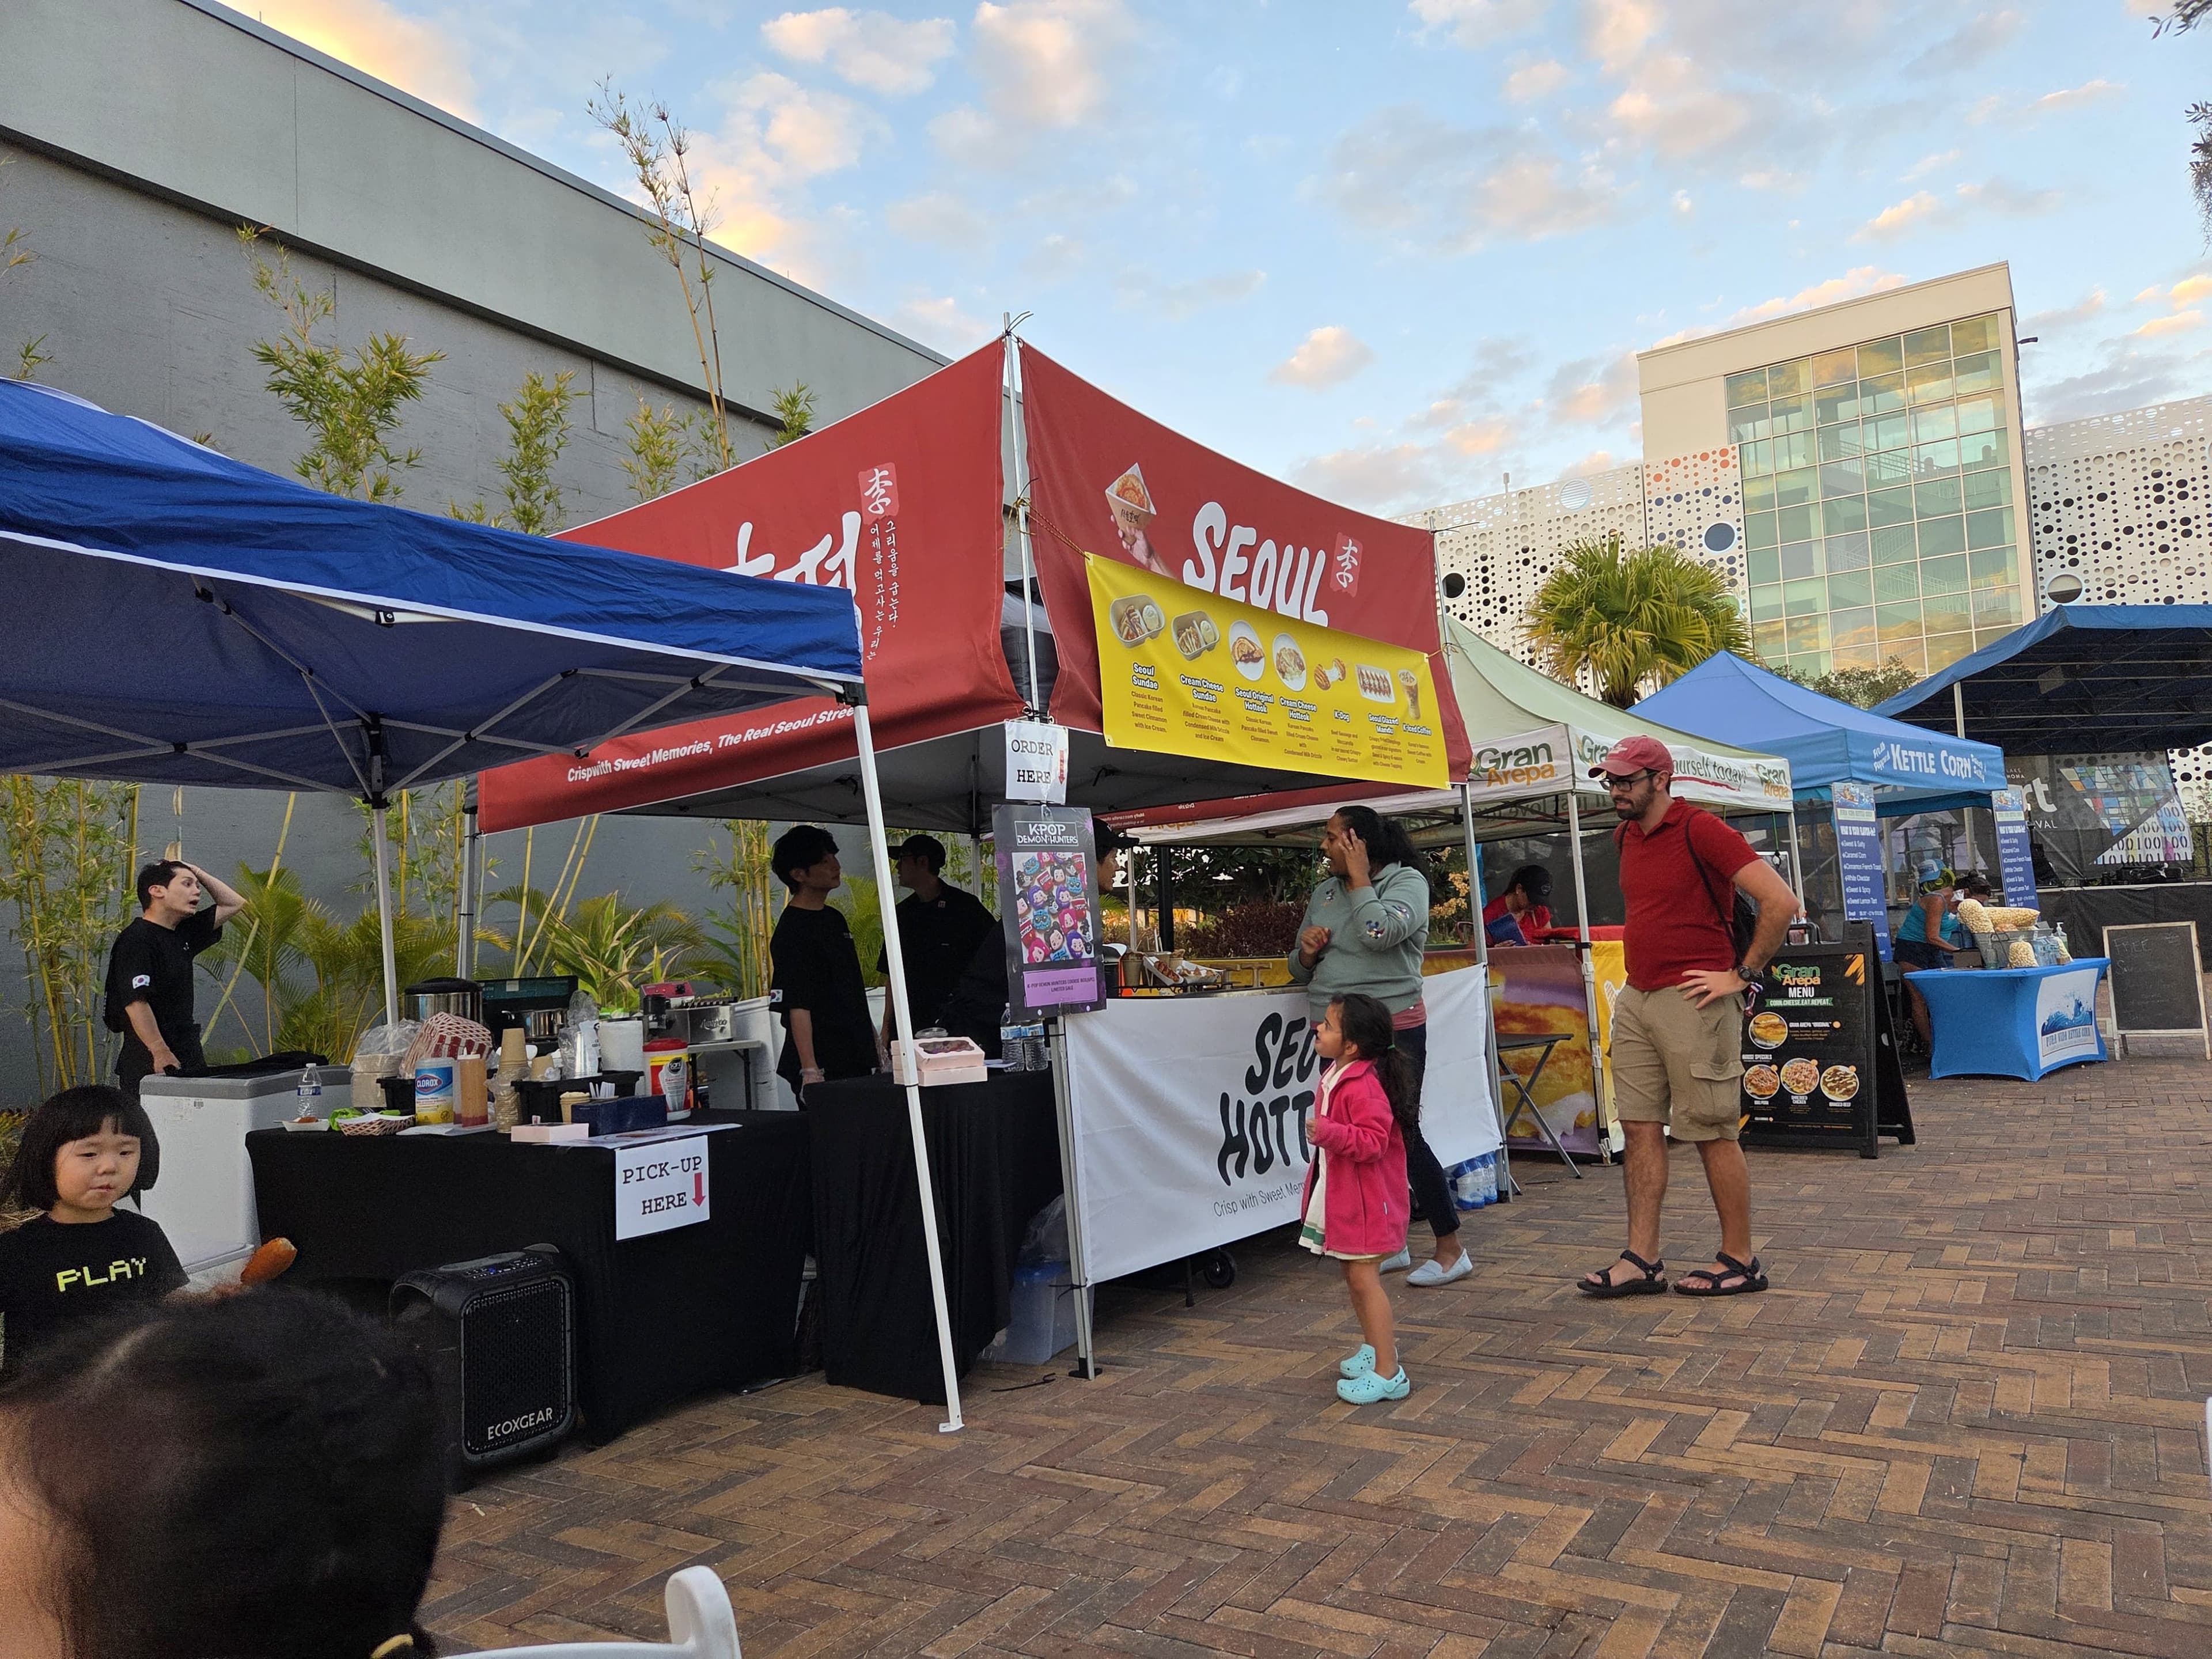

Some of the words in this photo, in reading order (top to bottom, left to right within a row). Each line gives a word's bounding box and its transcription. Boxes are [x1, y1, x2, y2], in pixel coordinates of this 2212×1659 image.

[870, 524, 883, 565] 어제를
[885, 520, 899, 577] 그리움을
[1183, 502, 1328, 627] SEOUL
[866, 626, 884, 660] 우리는
[1133, 662, 1154, 676] Seoul
[1132, 676, 1158, 690] Sundae
[1180, 674, 1202, 687] Cream
[1202, 678, 1224, 692] Cheese
[1131, 691, 1147, 699] Classic
[1148, 695, 1163, 703] Korean
[1192, 689, 1217, 703] Sundae
[1235, 687, 1252, 699] Seoul
[1252, 689, 1274, 703] Original
[1134, 702, 1152, 710] Pancake
[1244, 700, 1268, 714] Hotteok
[1279, 696, 1297, 709] Cream
[1297, 700, 1317, 712] Cheese
[1132, 711, 1145, 719] Sweet
[1146, 714, 1167, 723] Cinnamon
[1183, 710, 1195, 718] filled
[1289, 710, 1310, 722] Hotteok
[1334, 709, 1350, 722] K-Dog
[1368, 713, 1382, 724] Seoul
[1185, 721, 1209, 730] Condensed
[1417, 726, 1432, 736] Coffee
[613, 753, 650, 771] Sweet
[652, 741, 713, 764] Memories,
[718, 733, 741, 748] The
[743, 724, 775, 742] Real
[775, 714, 816, 734] Seoul
[1011, 739, 1053, 756] ORDER
[1582, 735, 1613, 764] Gra
[1476, 741, 1552, 773] Gran
[1017, 770, 1051, 784] HERE
[1486, 763, 1555, 787] Arepa
[1755, 763, 1786, 785] Gran
[1764, 782, 1789, 800] Arepa
[1017, 834, 1048, 844] DEMON
[1048, 835, 1078, 844] HUNTERS
[1778, 964, 1820, 978] Gran
[1782, 975, 1821, 987] Arepa
[1788, 986, 1815, 998] MENU
[417, 1079, 438, 1088] CLOROX
[1217, 1090, 1315, 1187] HOTT
[623, 1156, 702, 1184] PICK-UP
[642, 1192, 687, 1215] HERE
[1214, 1199, 1238, 1217] Crisp
[1239, 1193, 1259, 1210] with
[1259, 1187, 1286, 1205] Sweet
[56, 1257, 146, 1292] PLAY
[487, 1407, 553, 1440] ECOXGEAR
